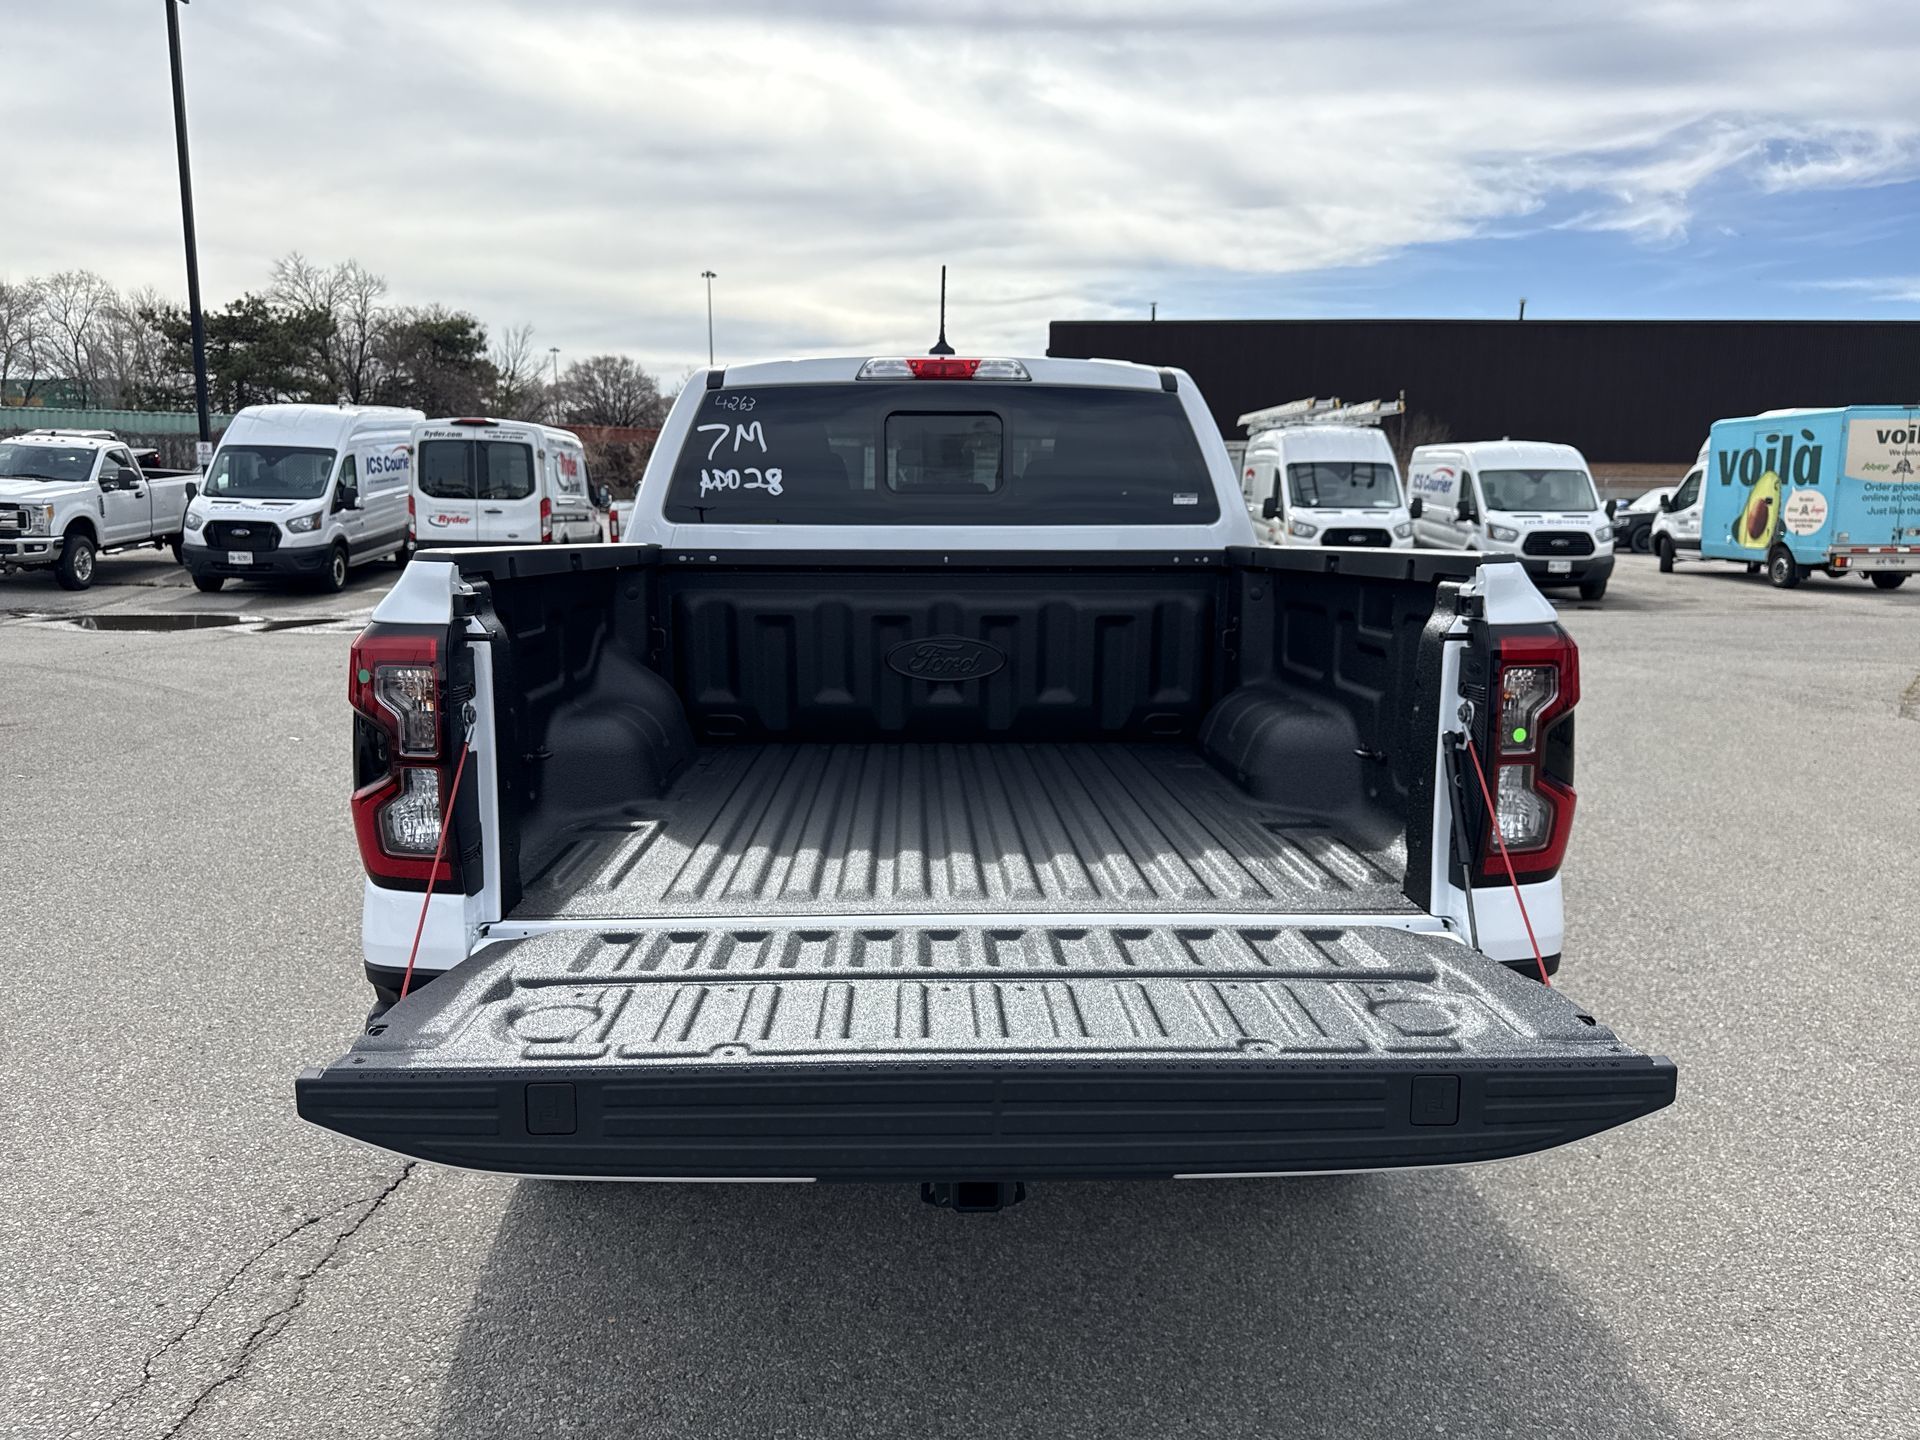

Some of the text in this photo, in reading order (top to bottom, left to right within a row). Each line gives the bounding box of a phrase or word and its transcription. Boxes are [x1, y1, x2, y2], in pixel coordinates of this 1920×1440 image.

[715, 395, 756, 411] 4263
[424, 430, 463, 439] Ryder.com
[366, 456, 383, 475] ICS
[437, 514, 471, 524] Ryder
[909, 643, 982, 673] Ford
